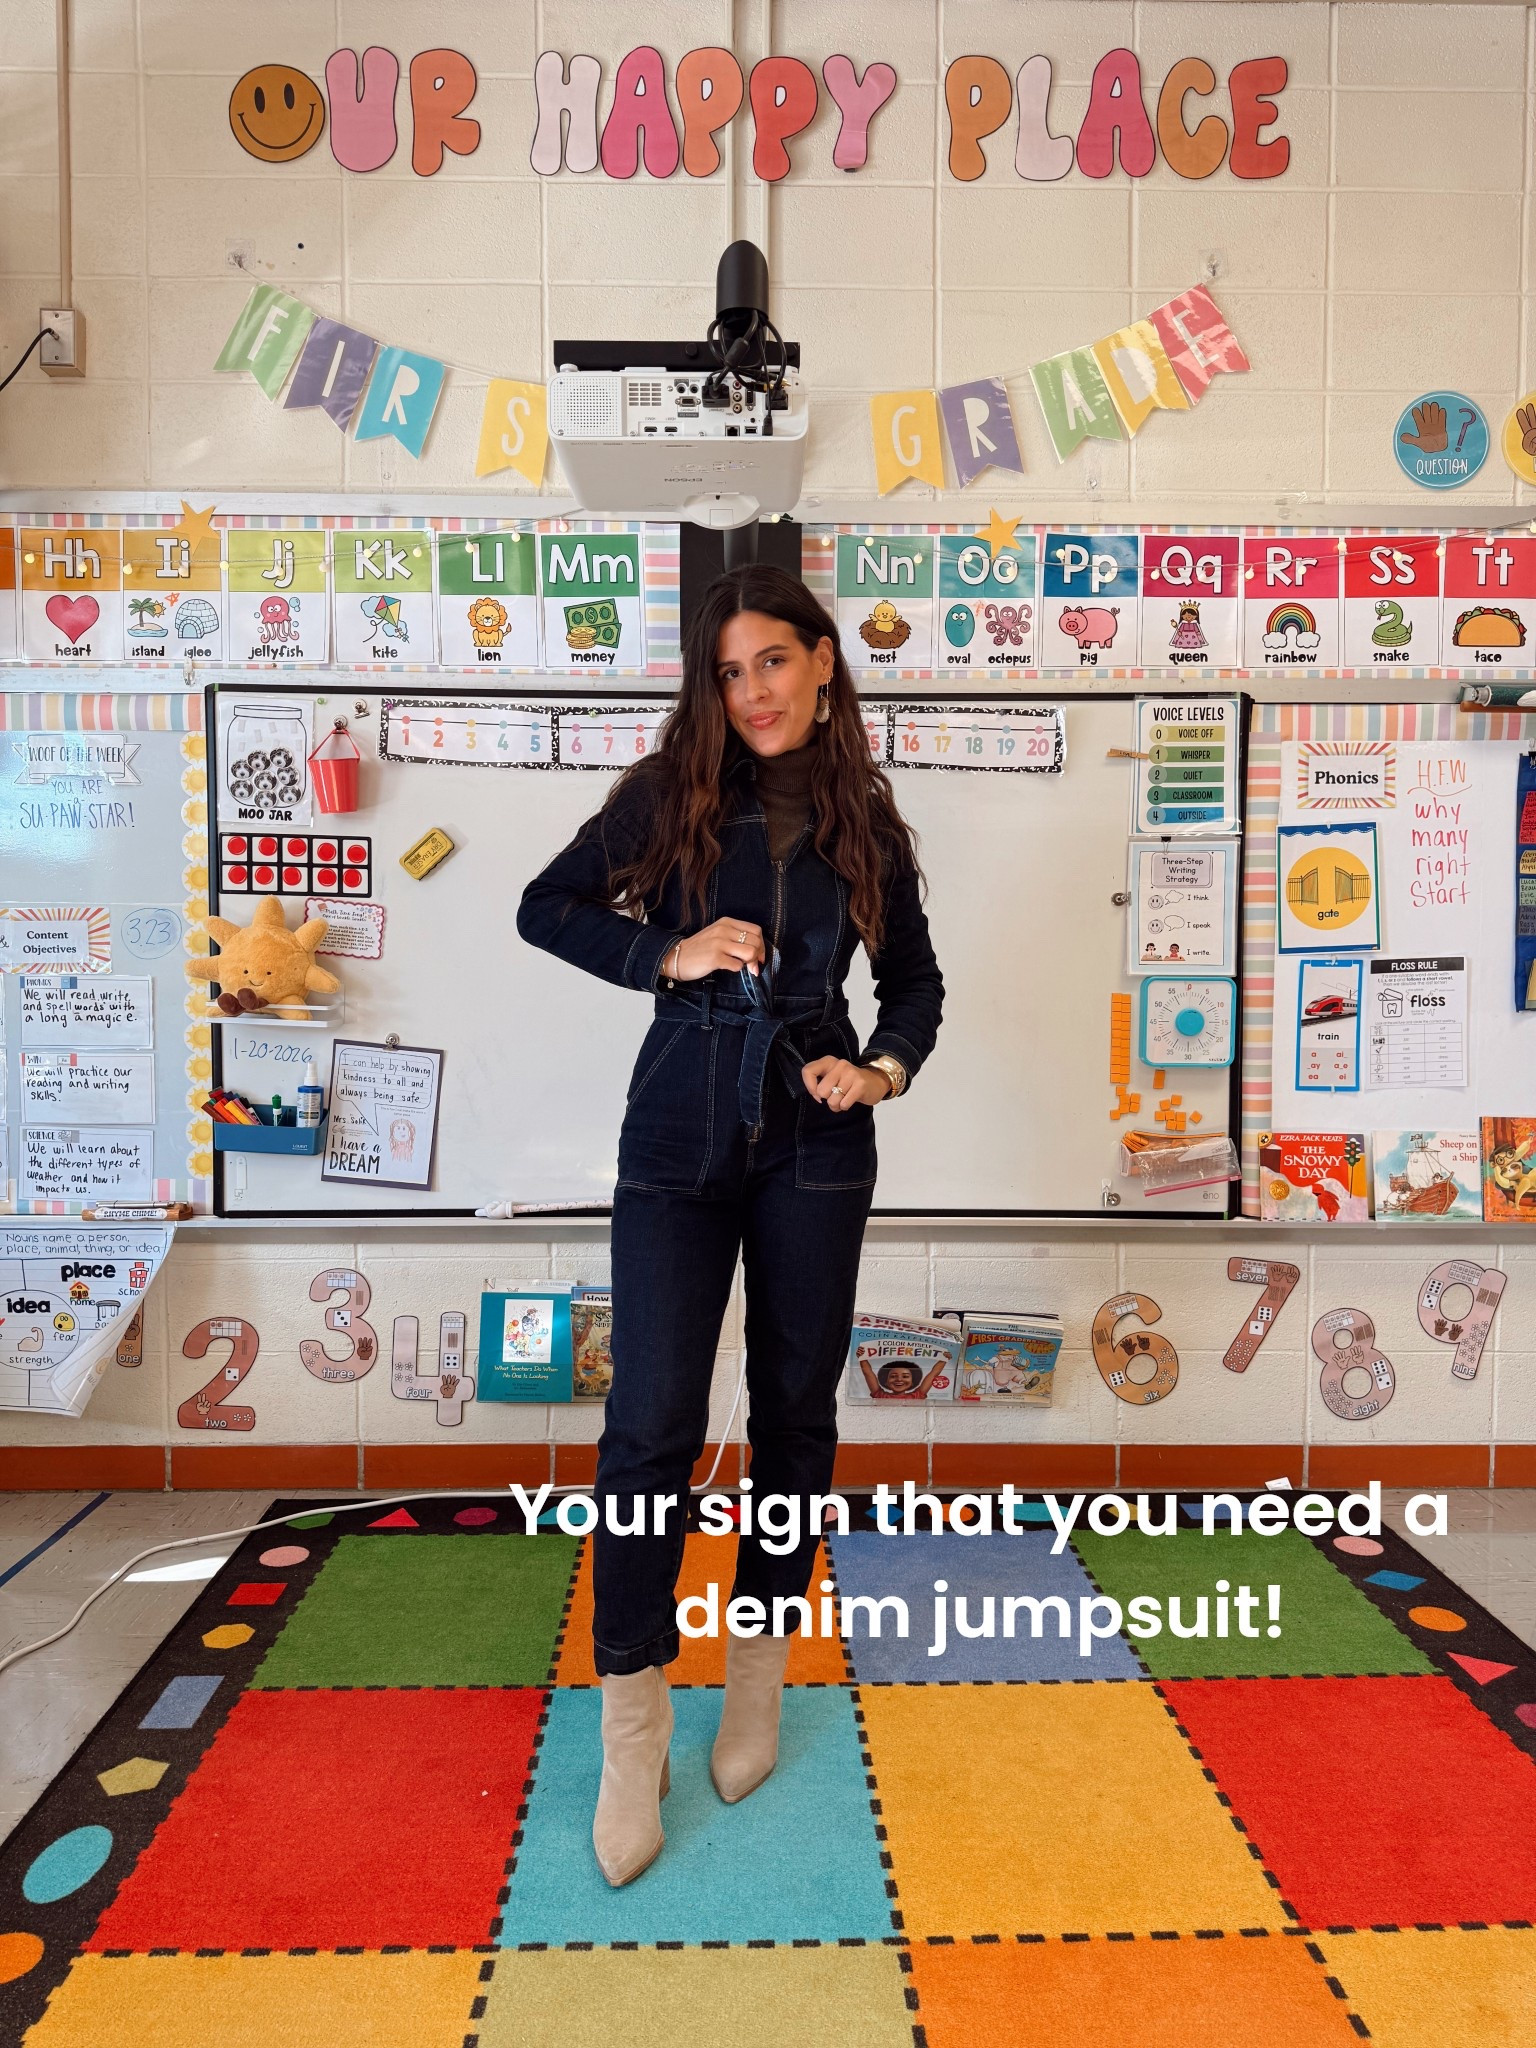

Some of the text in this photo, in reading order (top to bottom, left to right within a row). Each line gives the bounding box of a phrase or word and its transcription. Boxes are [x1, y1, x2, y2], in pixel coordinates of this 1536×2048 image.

[530, 46, 896, 181] HAPPY
[945, 49, 1289, 181] PLACE
[248, 305, 530, 456] FIRS
[892, 308, 1219, 467] GRADE
[1416, 458, 1468, 476] QUESTION
[44, 538, 101, 578] Hh
[156, 538, 190, 578] Ii
[262, 539, 295, 588] Jj
[355, 540, 412, 580] Kk
[472, 543, 504, 582] Ll
[549, 544, 634, 583] Mm
[857, 545, 915, 584] Nn
[957, 546, 1018, 585] Oo
[1063, 544, 1118, 593] Pp
[1161, 546, 1222, 594] Qq
[1266, 547, 1318, 586] Rr
[1370, 546, 1415, 585] Ss
[1472, 547, 1514, 585] Tt
[55, 644, 91, 657] heart
[132, 647, 212, 659] island igloo
[248, 646, 303, 660] jellyfish
[372, 646, 398, 658] kite
[478, 649, 501, 662] lion
[871, 651, 896, 663] nest
[1265, 651, 1317, 663] rainbow
[1374, 650, 1409, 662] snake
[1475, 651, 1501, 662] taco
[571, 651, 615, 664] money
[948, 652, 1031, 665] oval octopus
[1080, 652, 1098, 665] pig
[1169, 652, 1208, 664] queen
[1153, 707, 1223, 720] VOICE LEVELS
[1179, 729, 1214, 738] VOICE OFF
[902, 735, 1049, 756] 16 17 18 19 20
[29, 747, 123, 762] WOOF OF THE WEEK
[1181, 751, 1210, 759] WHISPER
[1184, 771, 1202, 779] QUIET
[1315, 771, 1378, 784] Phonics
[52, 780, 102, 795] YOU ARE
[1173, 791, 1212, 799] CLASSROOM
[239, 808, 292, 821] MOO JAR
[1179, 811, 1206, 819] OUTSIDE
[1416, 797, 1461, 824] why
[1412, 829, 1468, 854] many
[1417, 852, 1470, 885] right
[1318, 909, 1339, 921] gate
[27, 931, 68, 939] Content
[23, 945, 76, 955] Objectives
[1418, 961, 1437, 969] RULE
[1411, 995, 1445, 1007] floss
[234, 1038, 313, 1063] 1-20-2026
[341, 1054, 431, 1078] I can help by showing
[343, 1069, 423, 1088] kindness to all and
[340, 1088, 368, 1100] always
[374, 1088, 393, 1102] being
[28, 1132, 55, 1140] SCIENCE
[28, 1143, 140, 1156] We will learn about
[341, 1137, 368, 1150] have
[373, 1144, 382, 1153] a
[1301, 1146, 1325, 1154] THE
[1440, 1140, 1462, 1150] Sheep
[29, 1157, 140, 1170] the different types of
[329, 1151, 379, 1174] DREAM
[1284, 1155, 1343, 1166] SNOWY
[1459, 1153, 1477, 1163] Ship
[27, 1170, 121, 1184] weather and how it
[1299, 1167, 1329, 1178] DAY
[36, 1182, 90, 1197] impacts us.
[6, 1234, 39, 1242] Nouns
[89, 1234, 129, 1244] person,
[7, 1245, 40, 1255] place,
[45, 1245, 80, 1254] animal,
[84, 1244, 117, 1255] thing,
[136, 1243, 160, 1253] idea
[61, 1262, 116, 1282] place
[1236, 1271, 1268, 1284] seven
[7, 1298, 50, 1313] idea
[70, 1297, 95, 1306] home
[1223, 1257, 1300, 1373] 7
[1417, 1259, 1507, 1380] 9
[300, 1268, 378, 1383] 3
[53, 1333, 75, 1341] fear
[868, 1347, 942, 1357] DIFFERENT
[1092, 1293, 1179, 1405] 6
[9, 1356, 53, 1366] strength
[119, 1354, 139, 1363] one
[1311, 1308, 1395, 1420] 8
[178, 1317, 259, 1431] 2
[323, 1368, 354, 1378] three
[391, 1311, 474, 1426] 4
[1452, 1363, 1475, 1377] nine
[406, 1387, 432, 1397] four
[1143, 1390, 1160, 1401] six
[1352, 1400, 1379, 1417] eight
[205, 1418, 227, 1428] two
